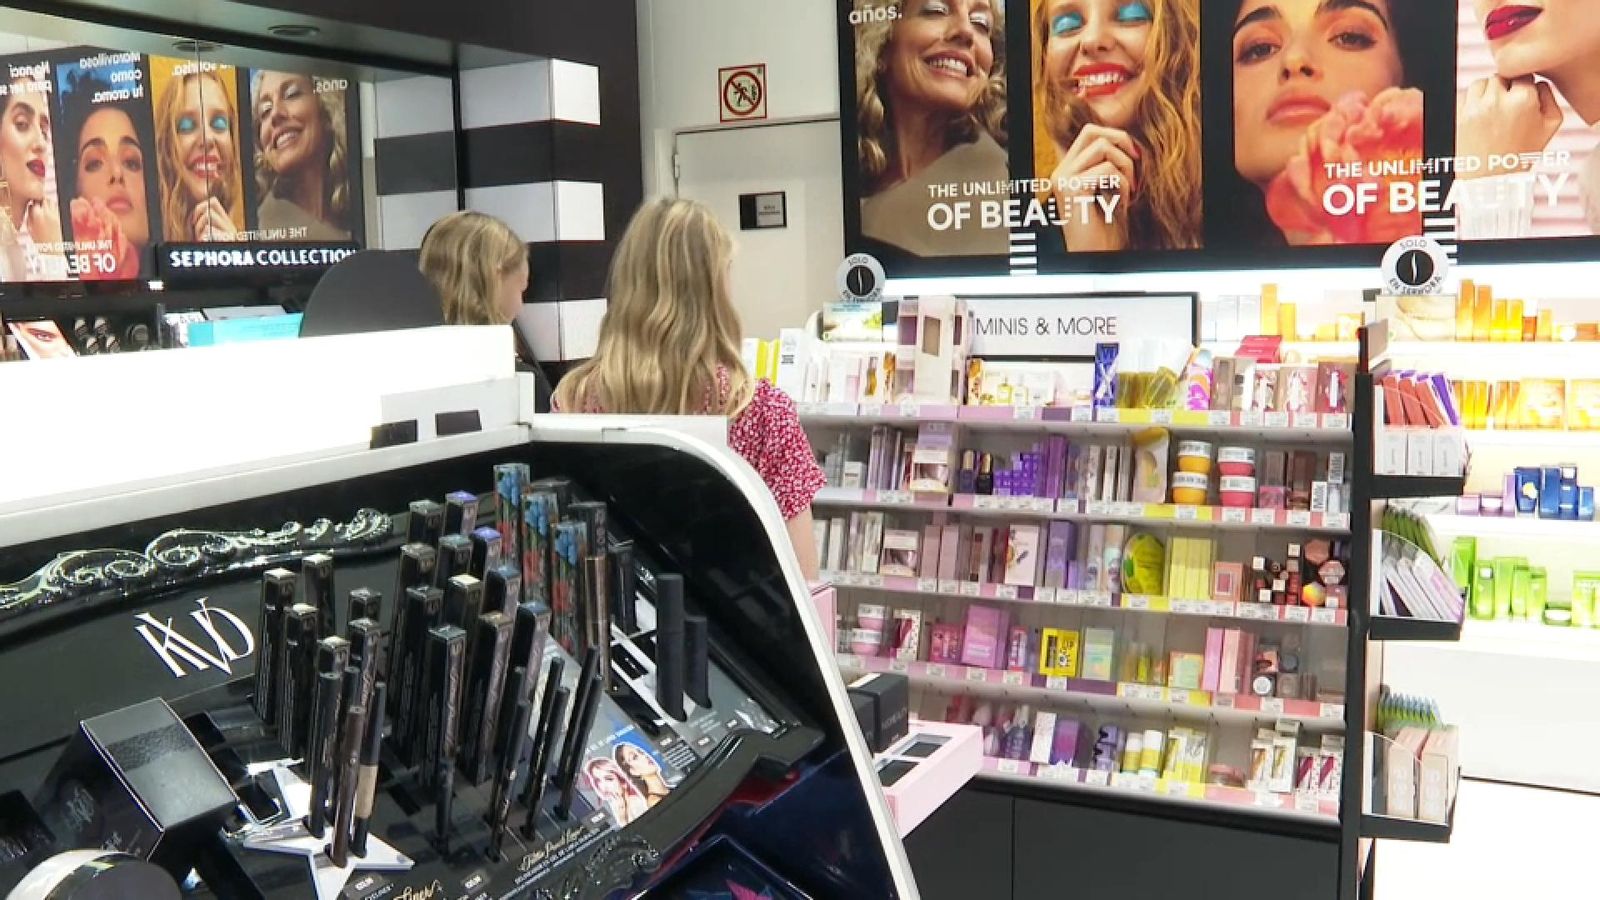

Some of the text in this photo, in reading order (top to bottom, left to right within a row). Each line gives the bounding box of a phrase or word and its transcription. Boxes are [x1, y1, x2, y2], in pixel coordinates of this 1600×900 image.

[849, 4, 903, 24] años.
[1323, 150, 1570, 179] THE UNLIMITED POWER
[928, 174, 1121, 198] THE UNLIMITED POWER
[1322, 172, 1570, 216] OF BEAUTY
[927, 194, 1121, 231] OF BEAUTY
[1400, 239, 1428, 250] SOLO
[168, 250, 255, 267] SEPHORA
[976, 316, 1118, 336] MINIS & MORE
